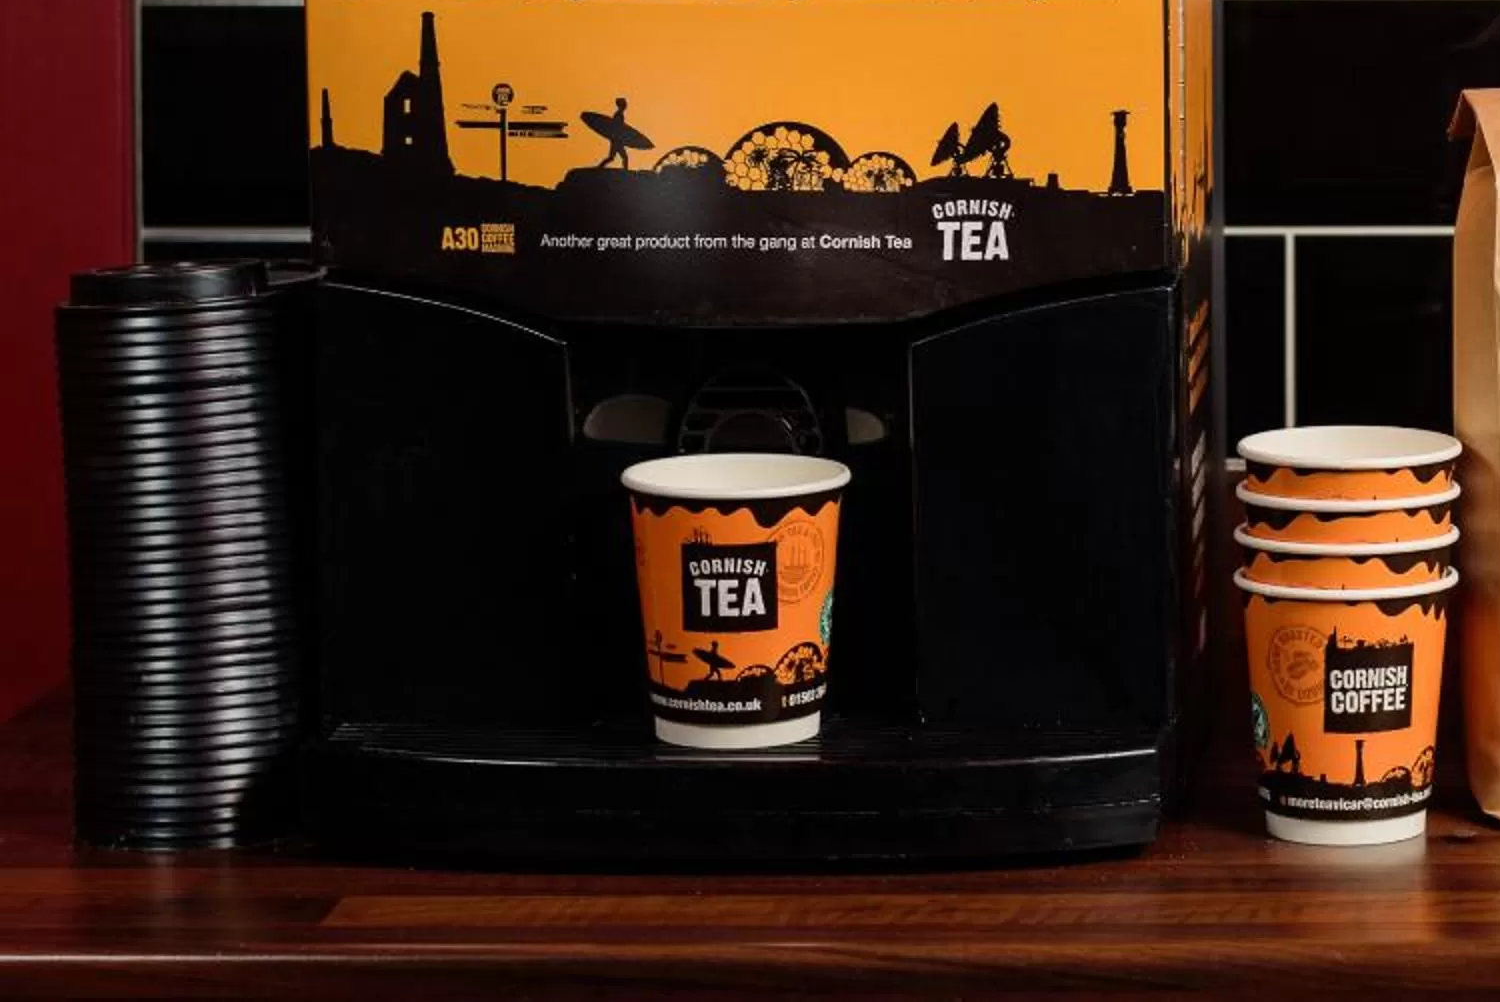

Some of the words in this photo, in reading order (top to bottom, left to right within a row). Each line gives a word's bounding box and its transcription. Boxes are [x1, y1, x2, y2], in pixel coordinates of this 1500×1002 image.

[932, 199, 1012, 220] CORNISH
[441, 227, 479, 251] A30
[540, 234, 594, 248] Another
[597, 234, 632, 251] great
[635, 234, 690, 251] product
[694, 234, 727, 248] from
[731, 234, 755, 249] the
[759, 236, 797, 251] gang
[801, 235, 815, 249] at
[819, 234, 881, 249] Cornish
[884, 235, 912, 249] Tea
[937, 221, 1009, 261] TEA
[689, 558, 767, 577] CORNISH
[694, 577, 767, 617] TEA
[1330, 665, 1408, 691] CORNISH
[1331, 687, 1407, 715] COFFEE
